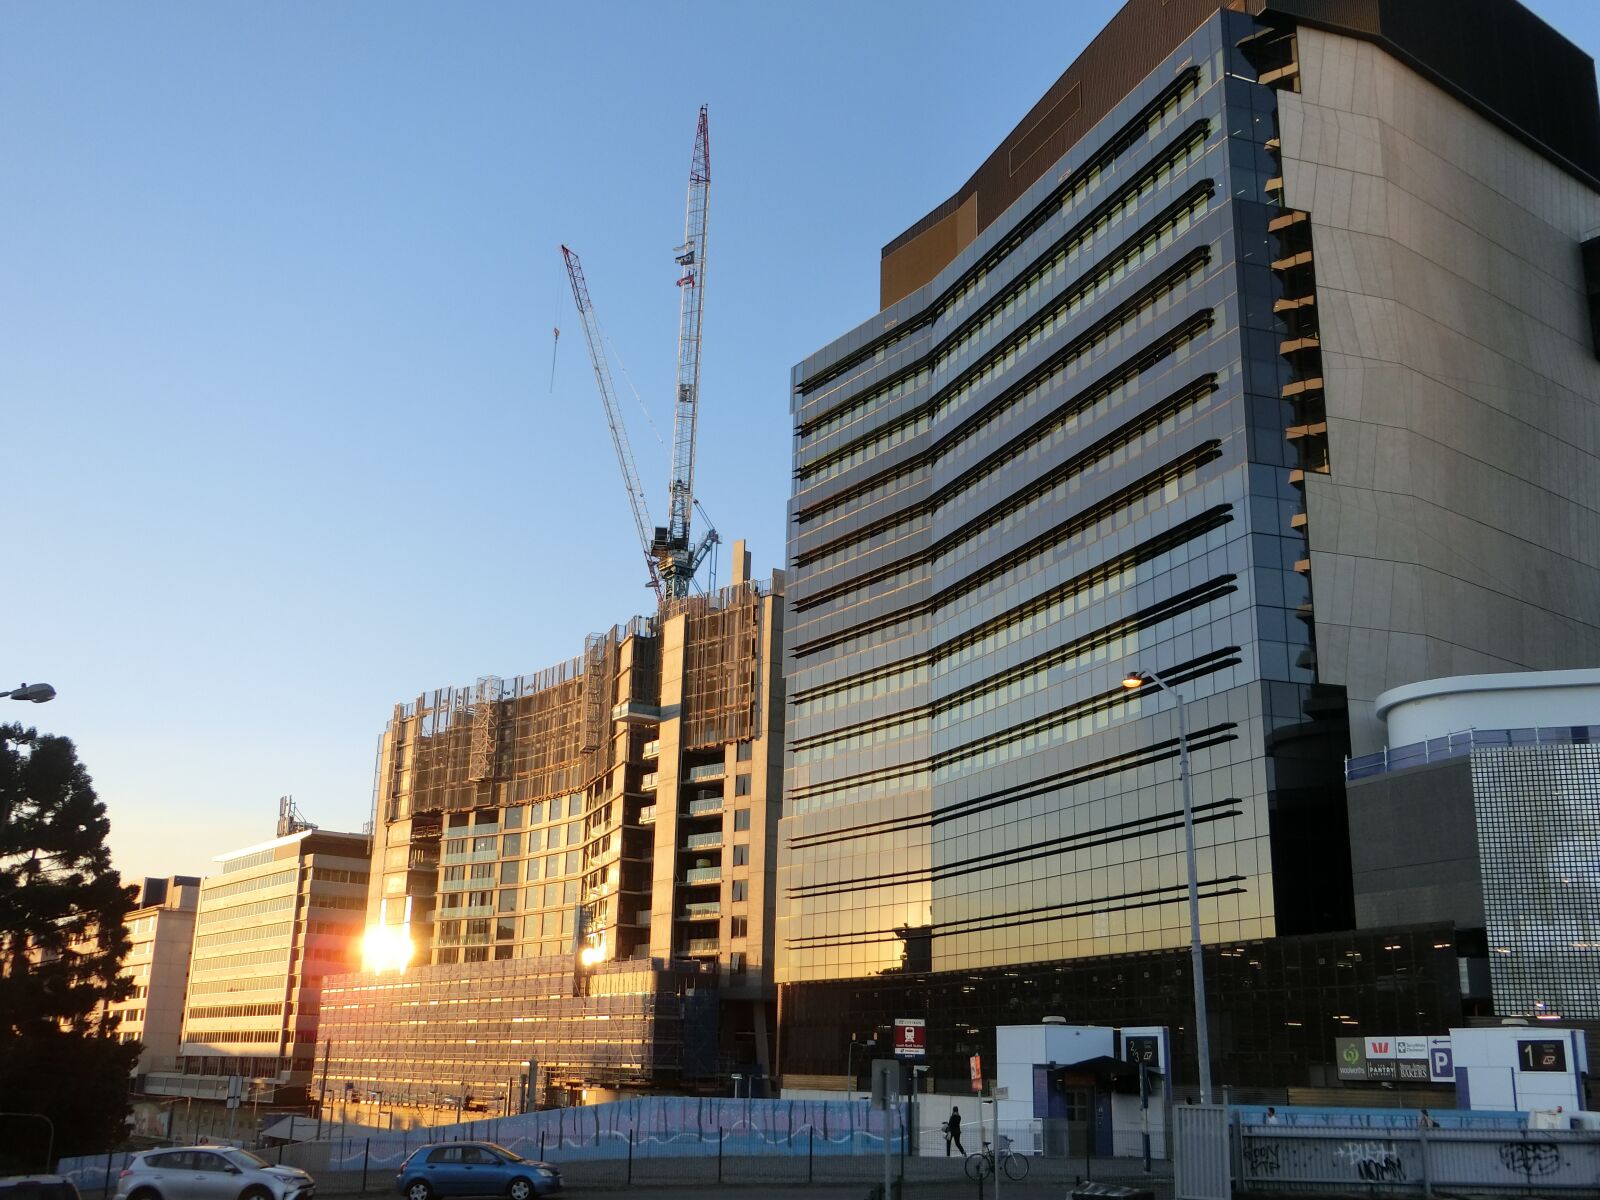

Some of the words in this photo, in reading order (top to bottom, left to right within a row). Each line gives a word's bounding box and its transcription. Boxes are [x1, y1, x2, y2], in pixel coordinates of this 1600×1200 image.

[1435, 1052, 1448, 1073] P
[1525, 1044, 1533, 1067] 1
[1400, 1069, 1427, 1078] BAKERS
